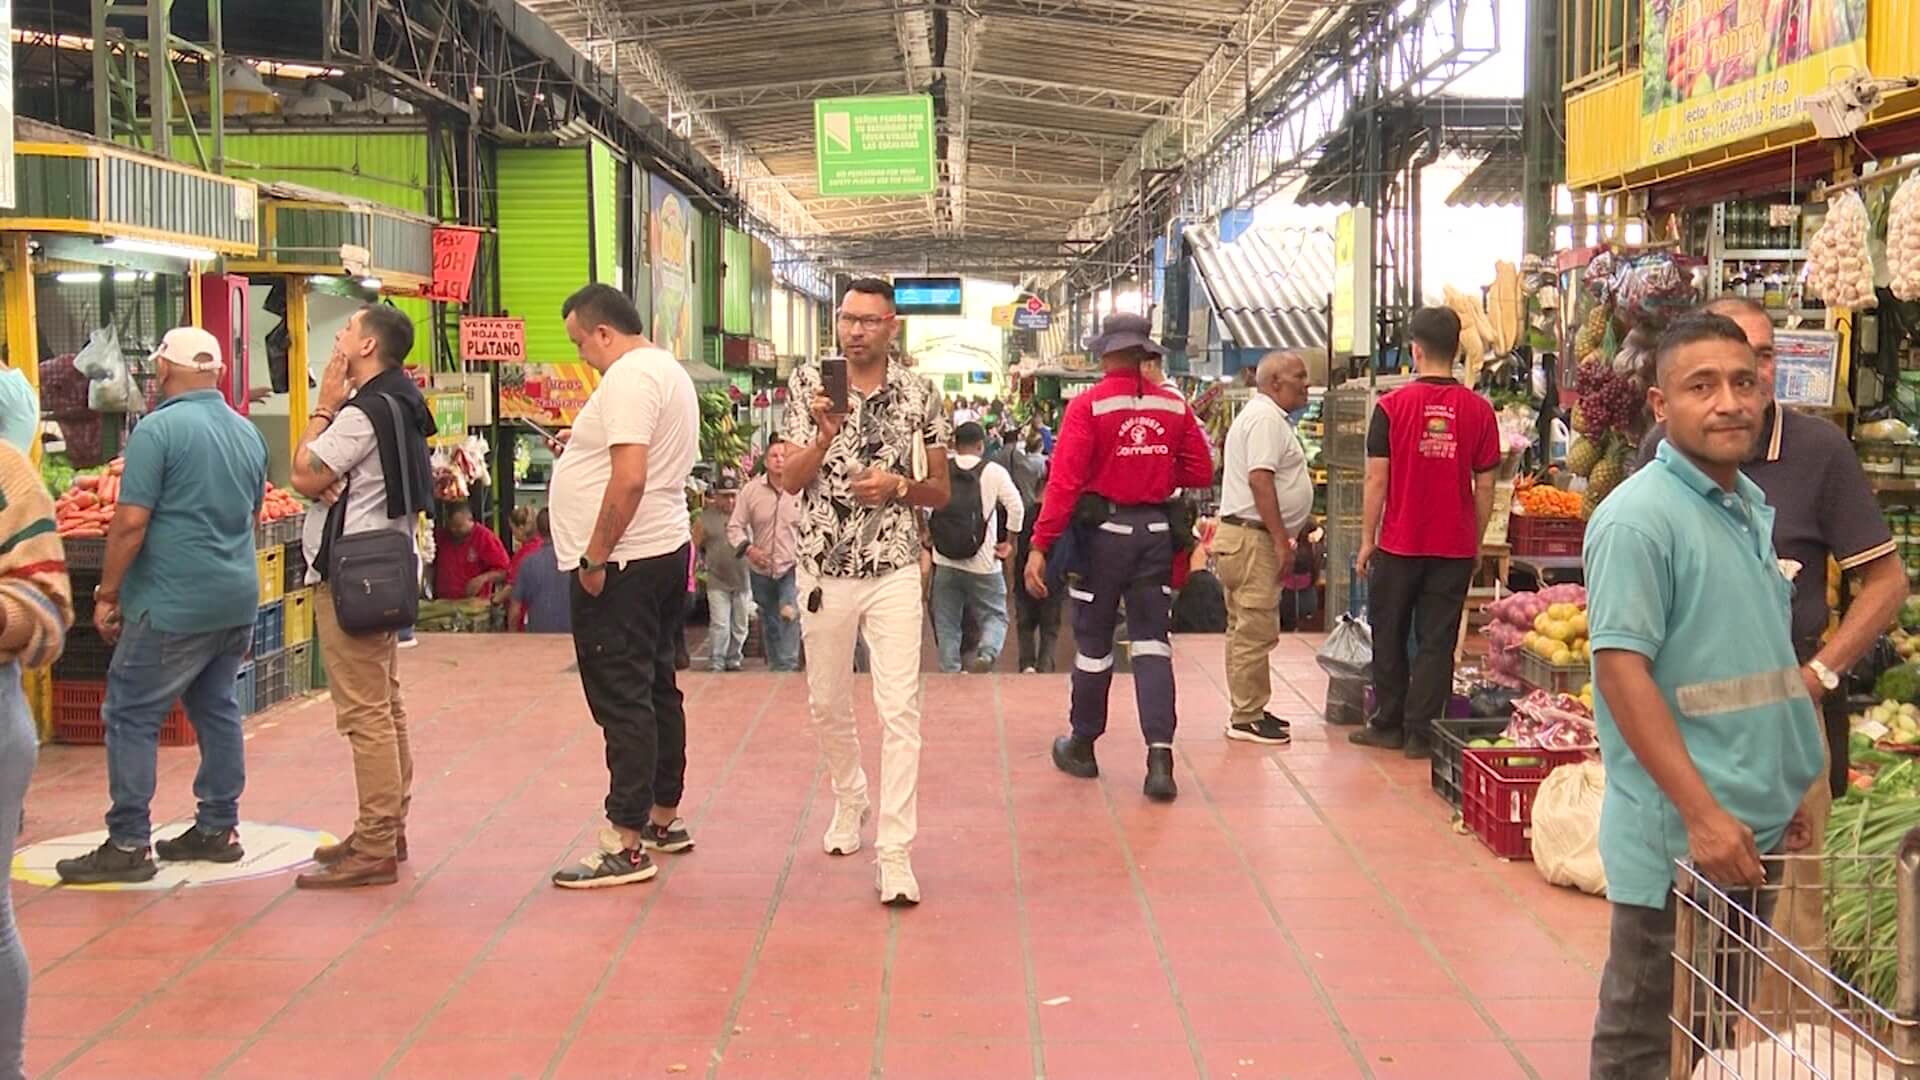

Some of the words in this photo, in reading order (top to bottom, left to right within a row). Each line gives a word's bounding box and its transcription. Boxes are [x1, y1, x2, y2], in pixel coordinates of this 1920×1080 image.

[471, 330, 499, 339] HOJA
[502, 331, 515, 340] DE
[467, 341, 521, 357] PLATANO
